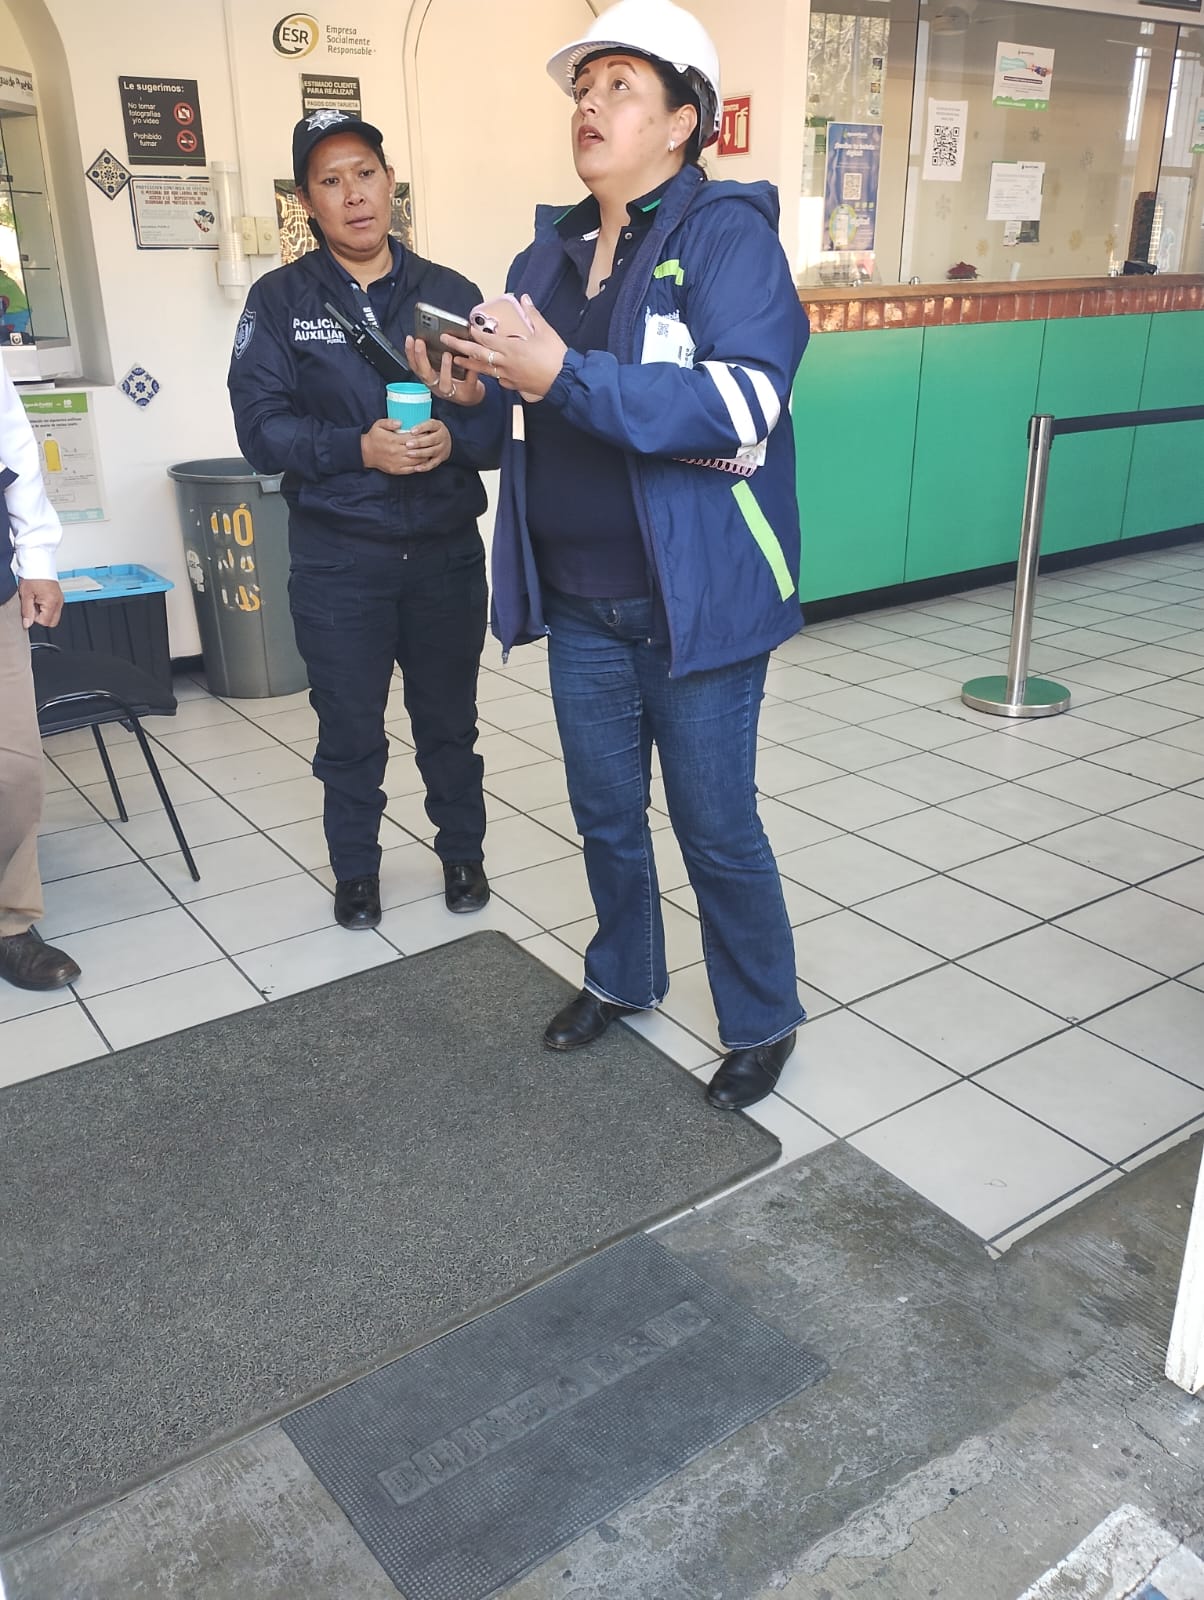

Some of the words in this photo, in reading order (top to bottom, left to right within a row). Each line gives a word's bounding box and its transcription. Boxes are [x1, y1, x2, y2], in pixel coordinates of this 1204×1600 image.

[326, 25, 357, 35] Empresa
[282, 27, 309, 45] ESR
[326, 35, 371, 45] Socialmente
[327, 45, 372, 55] Responsable
[123, 81, 134, 90] Le
[136, 83, 185, 93] sugerimos:
[304, 80, 333, 88] ESTIMADO
[133, 132, 162, 140] Prohibido
